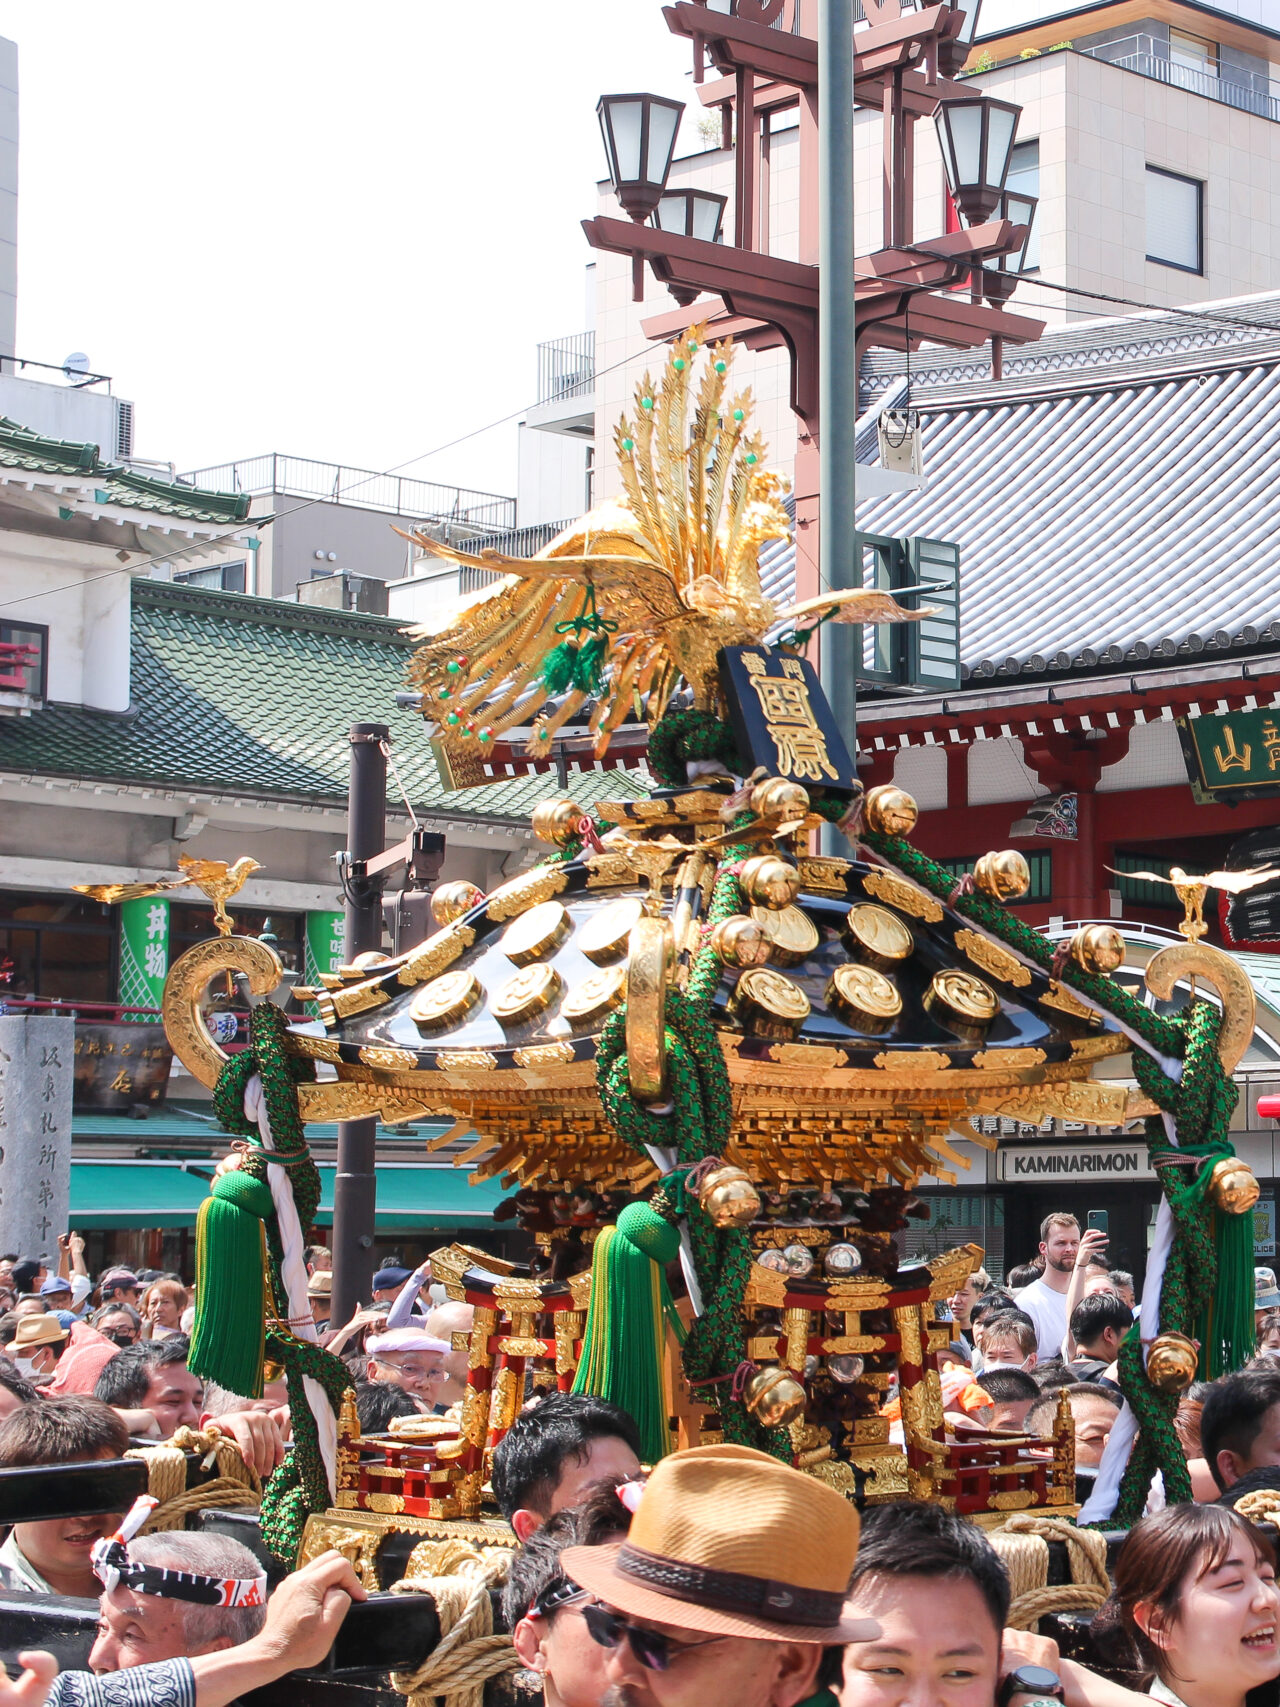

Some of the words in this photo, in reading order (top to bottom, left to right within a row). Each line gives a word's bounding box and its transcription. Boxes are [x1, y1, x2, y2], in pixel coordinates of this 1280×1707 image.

[144, 904, 167, 979] 丼物
[1014, 1152, 1139, 1174] KAMINARIMON
[1253, 1245, 1274, 1253] OLICE
